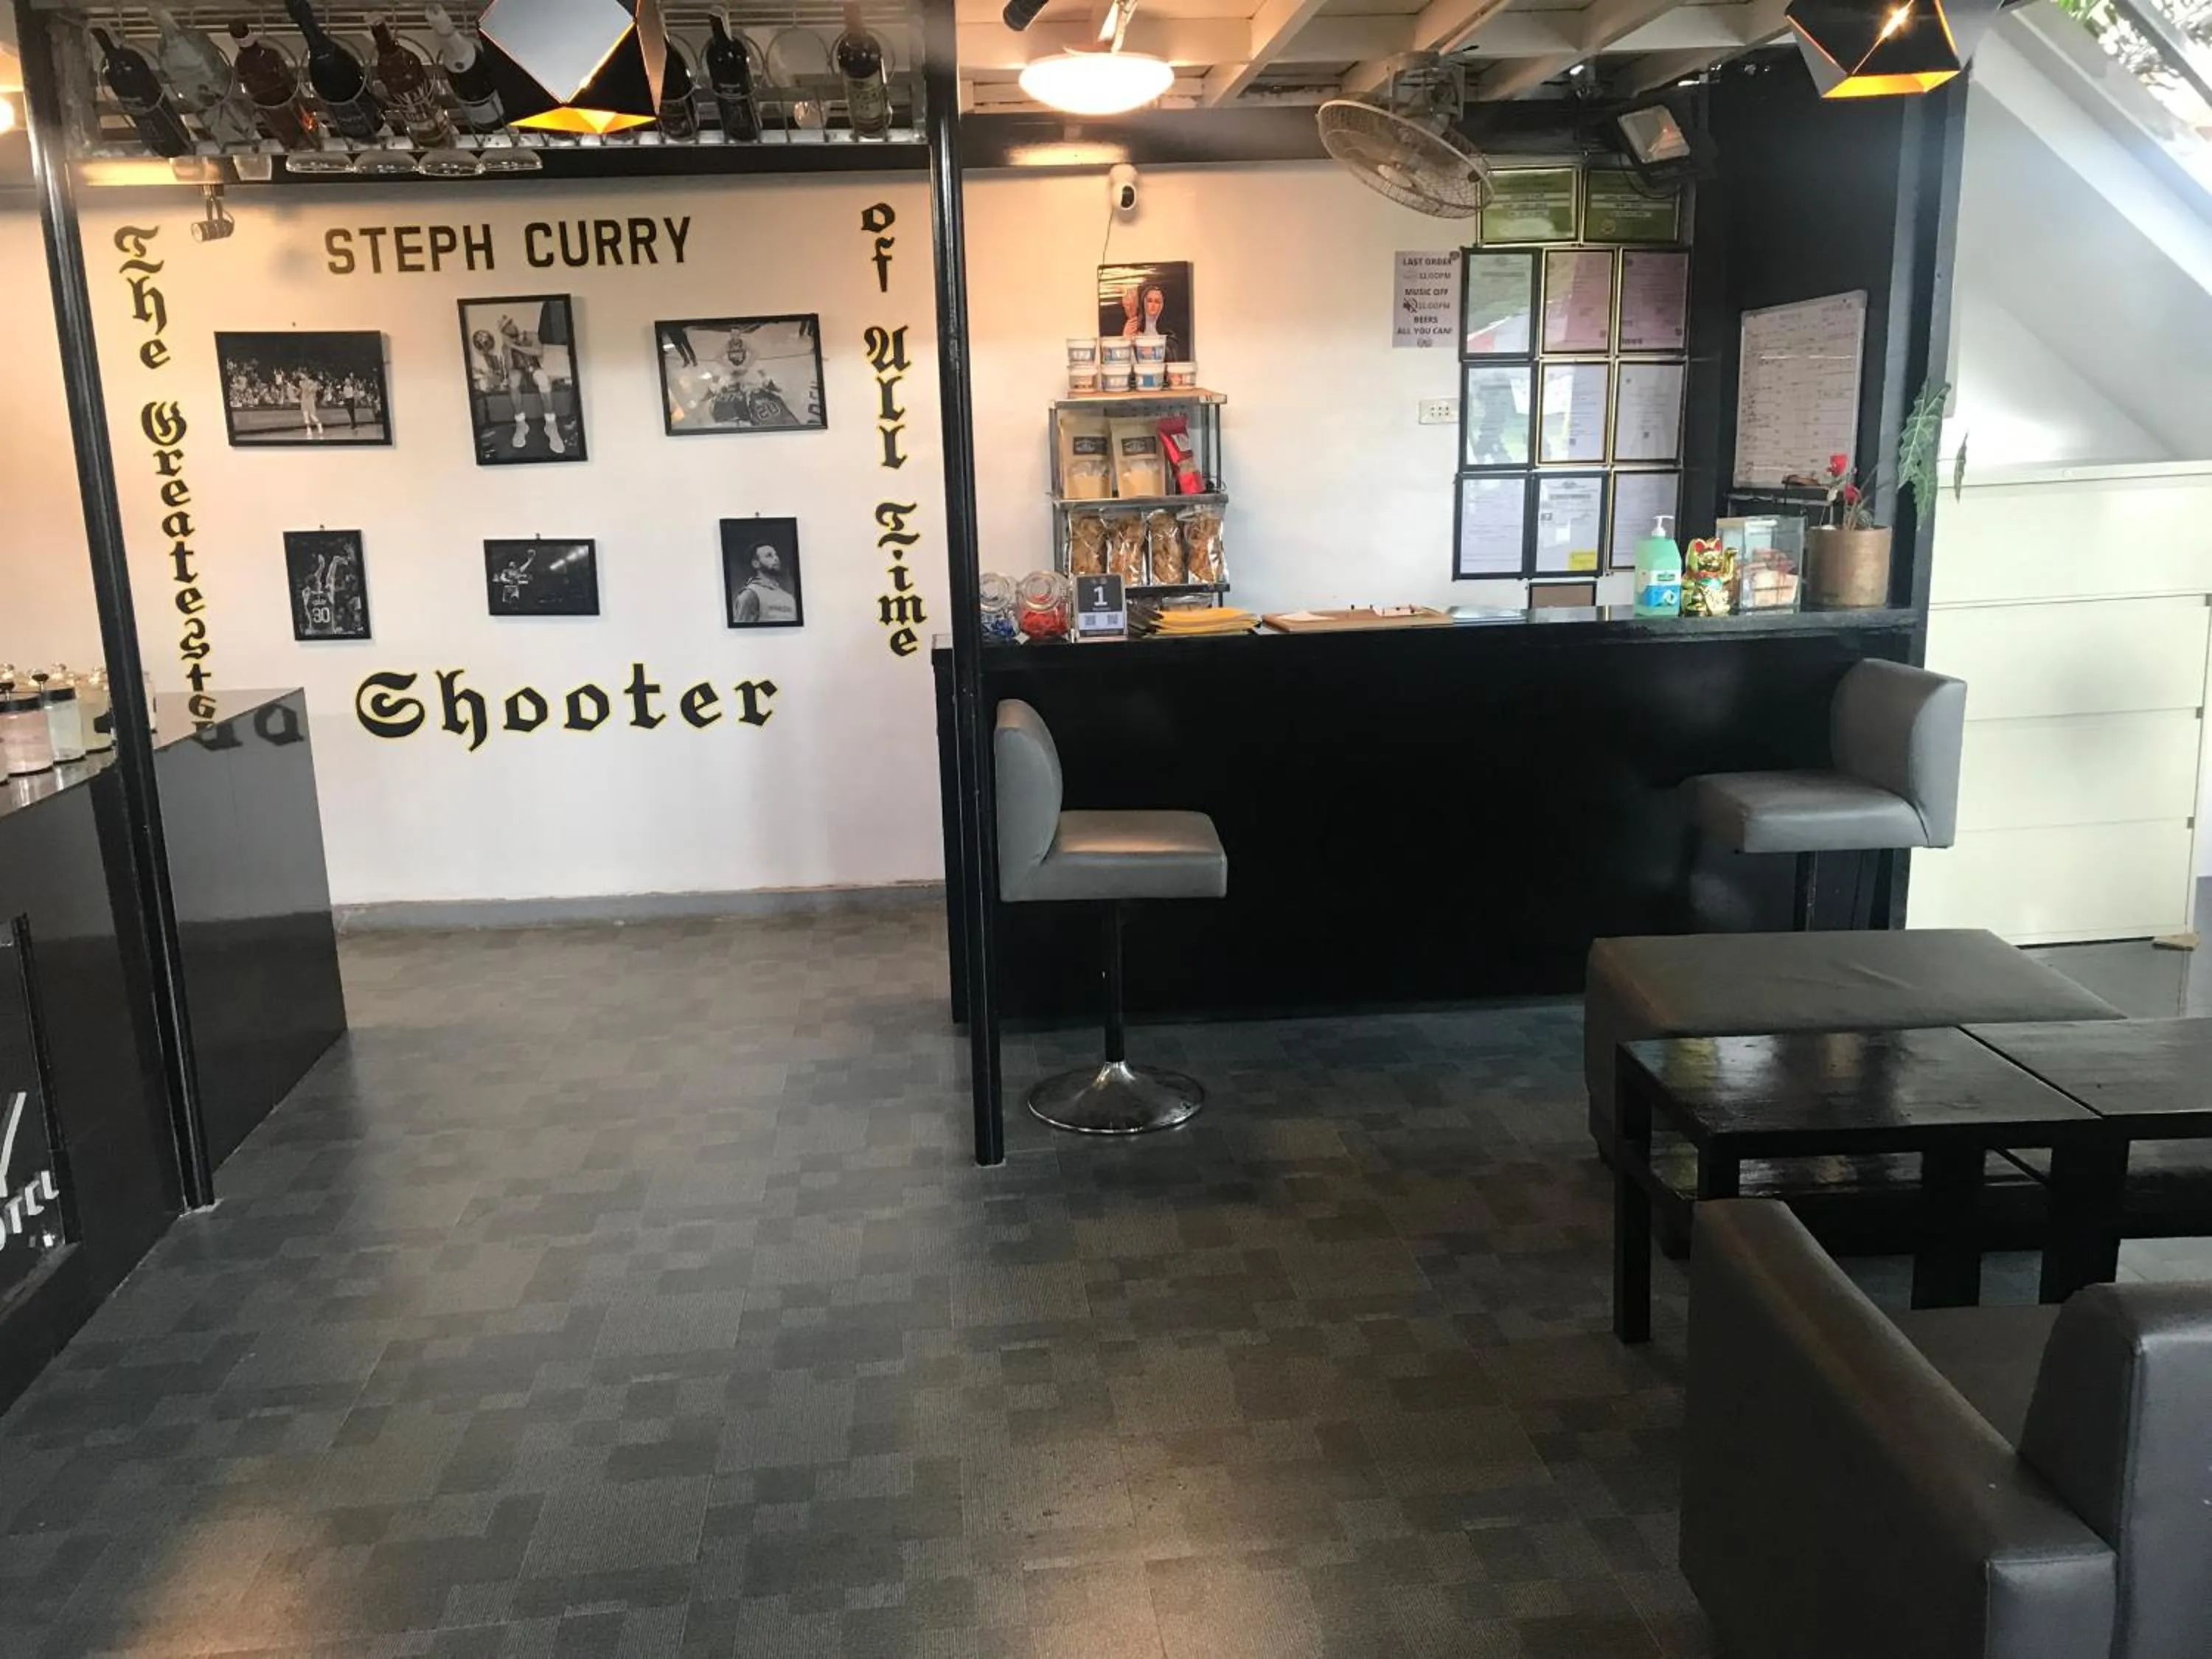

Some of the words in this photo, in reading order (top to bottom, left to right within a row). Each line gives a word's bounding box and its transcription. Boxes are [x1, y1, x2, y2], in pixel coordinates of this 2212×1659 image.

[324, 223, 495, 274] STEPH
[524, 216, 691, 268] CURRY
[860, 202, 896, 293] of
[114, 225, 171, 370] The
[863, 324, 911, 470] All
[312, 607, 330, 623] 30
[874, 501, 928, 658] Time
[1093, 585, 1108, 606] 1
[355, 663, 779, 752] Shooter
